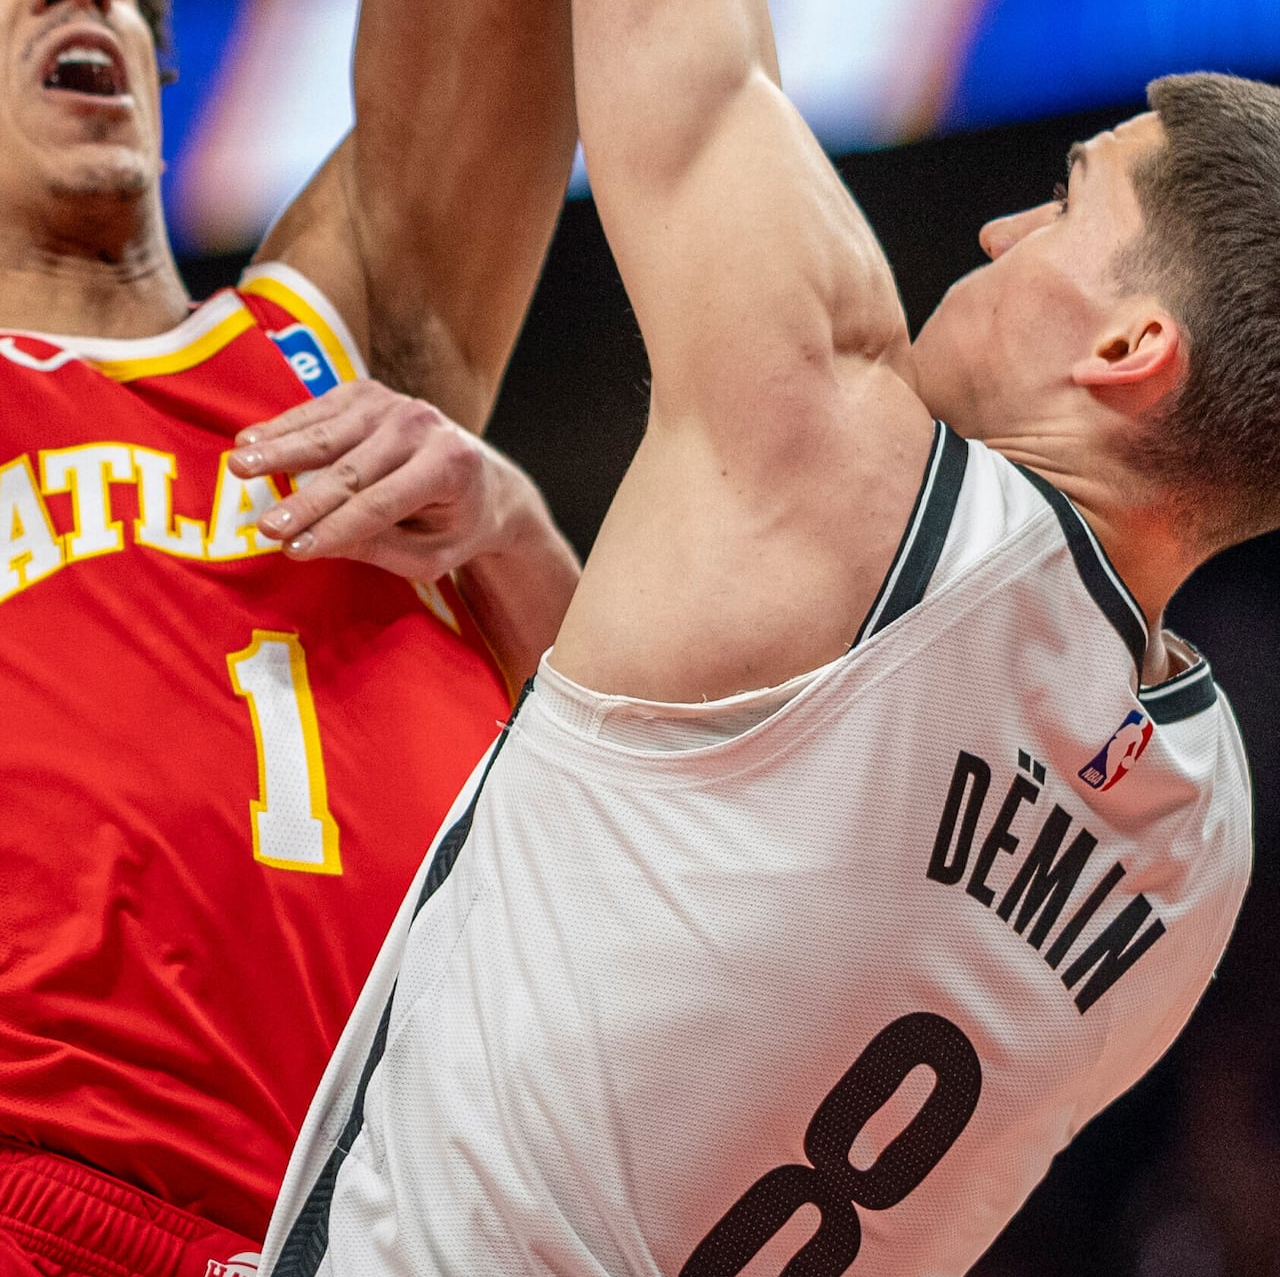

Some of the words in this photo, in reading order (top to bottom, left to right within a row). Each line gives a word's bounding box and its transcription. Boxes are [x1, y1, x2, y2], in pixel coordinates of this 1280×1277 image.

[226, 628, 343, 876] 1
[1081, 767, 1104, 786] NBA
[926, 748, 1166, 1015] DËMIN
[679, 1011, 982, 1277] 8
